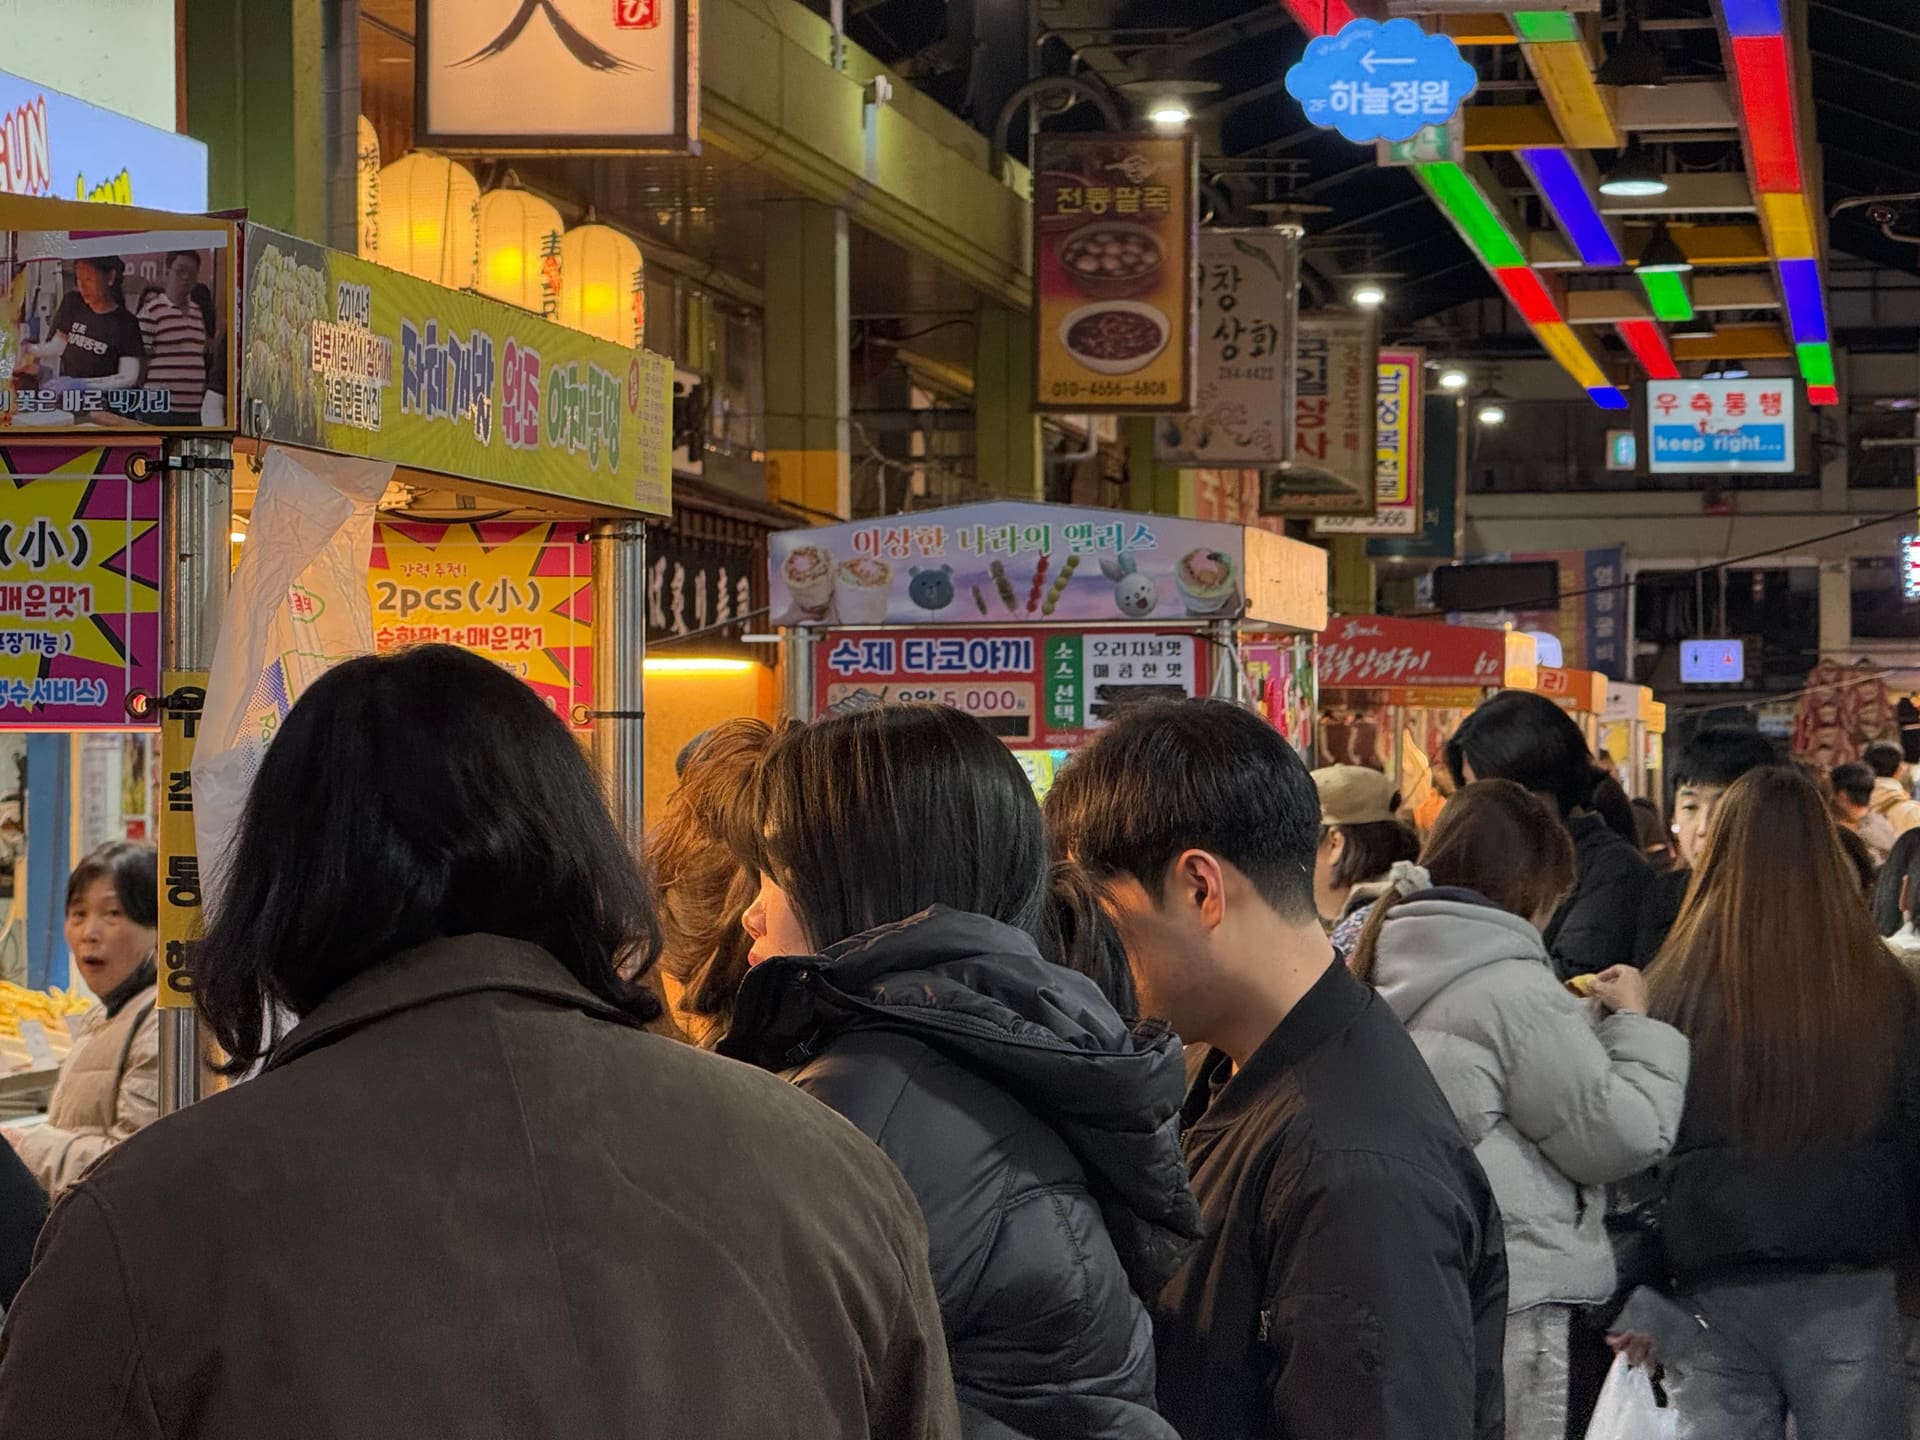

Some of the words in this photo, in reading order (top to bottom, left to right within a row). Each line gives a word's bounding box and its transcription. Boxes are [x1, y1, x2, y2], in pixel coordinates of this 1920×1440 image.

[1329, 80, 1450, 115] 하늘정원
[338, 286, 370, 328] 2014년
[1212, 317, 1279, 361] 상회
[16, 389, 57, 412] 꽃은
[62, 389, 103, 412] 바로
[107, 389, 171, 413] 먹거리
[502, 339, 541, 446] 원조
[1657, 435, 1705, 455] keep
[854, 527, 945, 557] 이상한
[960, 524, 1051, 554] 나라의
[1064, 522, 1158, 552] 앨리스
[401, 564, 430, 577] 강력
[435, 564, 467, 577] 추천!
[832, 641, 893, 672] 수제
[904, 640, 1031, 671] 타코야끼
